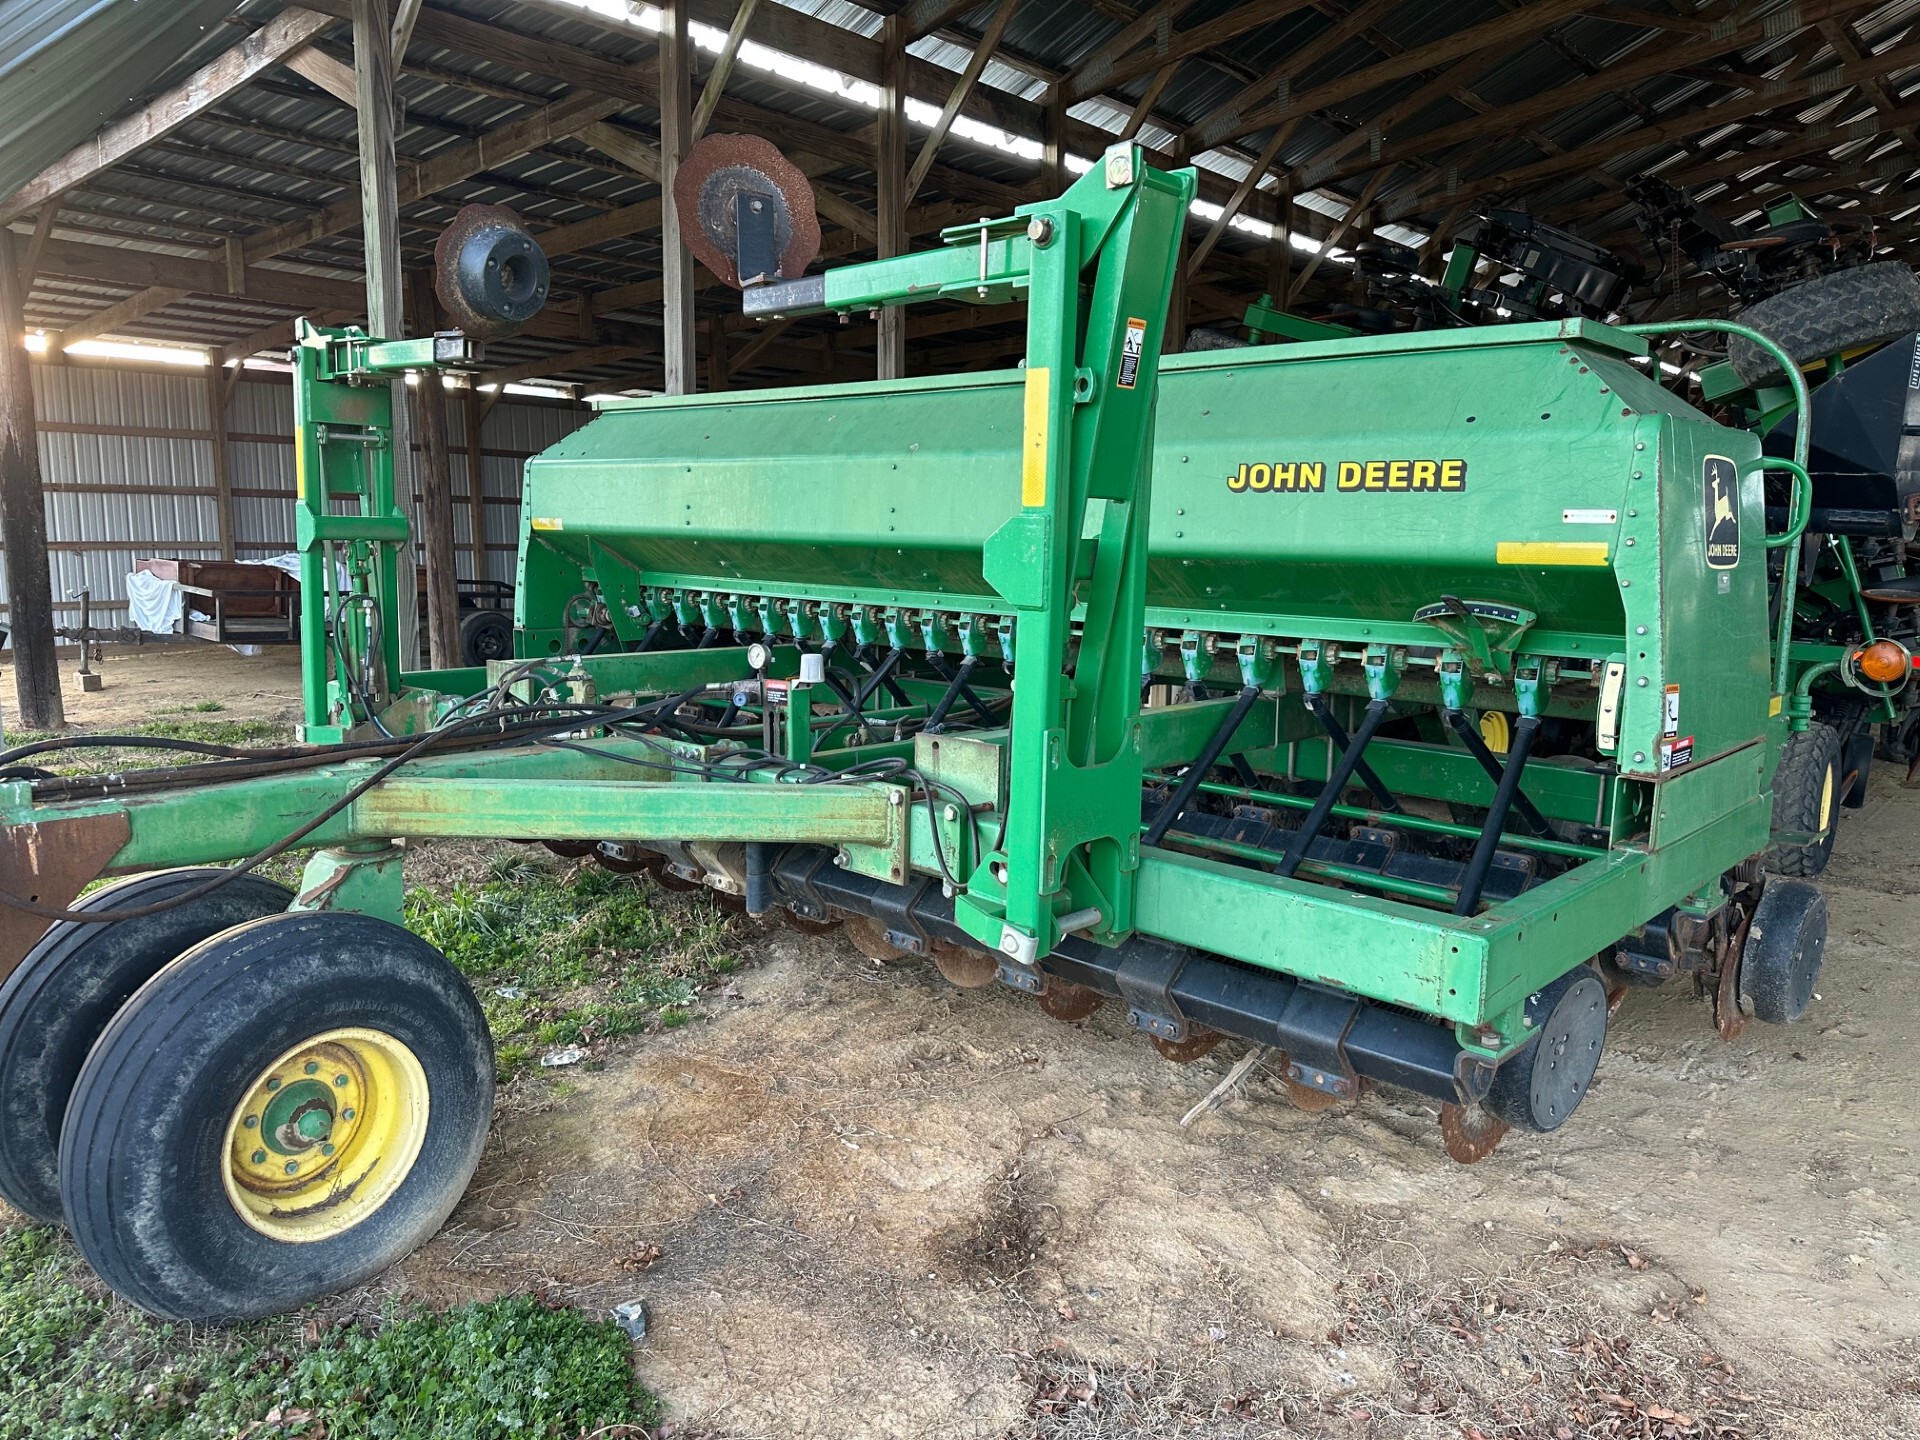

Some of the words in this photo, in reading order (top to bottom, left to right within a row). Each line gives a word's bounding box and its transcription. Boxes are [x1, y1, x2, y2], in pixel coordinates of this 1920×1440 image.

[1227, 462, 1326, 493] JOHN
[1337, 459, 1467, 492] DEERE
[1708, 544, 1721, 557] JOHN
[1722, 544, 1737, 557] DEERE
